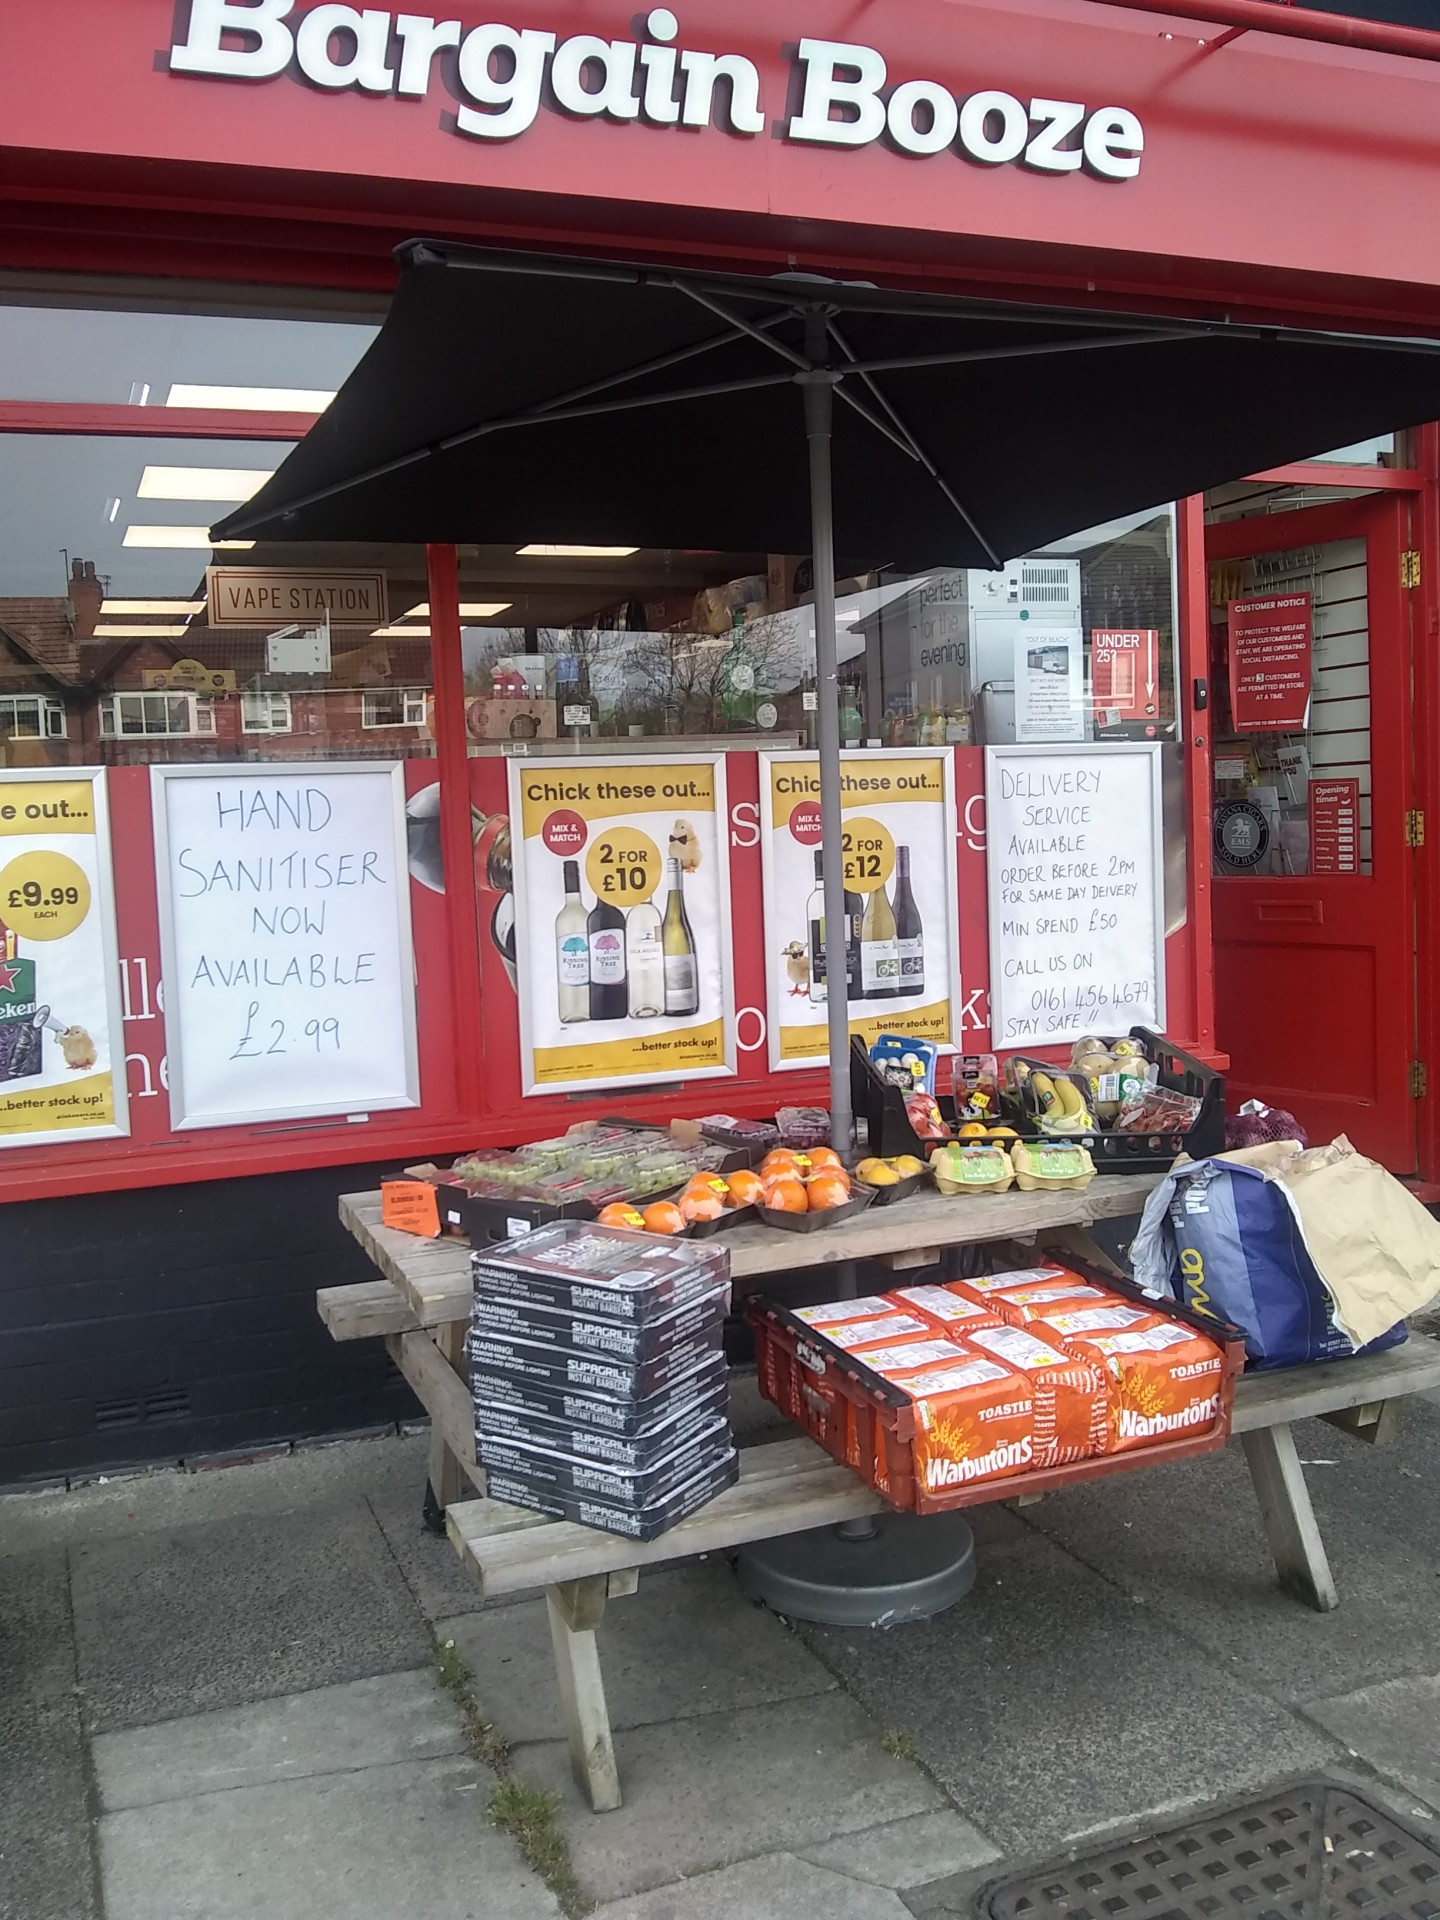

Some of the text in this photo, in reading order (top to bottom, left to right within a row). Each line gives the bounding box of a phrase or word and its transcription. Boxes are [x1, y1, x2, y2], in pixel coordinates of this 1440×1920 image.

[170, 0, 1145, 178] Bargain Booze
[228, 587, 370, 610] VAPE STATION
[920, 575, 963, 613] perfect
[1235, 598, 1306, 612] CUSTOMER NOTICE
[1245, 627, 1268, 636] PROTECT
[1282, 623, 1306, 632] WELFARE
[1258, 634, 1291, 644] CUSTOMERS
[1096, 634, 1140, 648] UNDER
[1262, 645, 1273, 653] ARE
[1273, 642, 1306, 652] OPERATING
[921, 638, 966, 667] evening
[1096, 648, 1117, 663] 25?
[1242, 656, 1261, 664] SOCIAL
[1237, 685, 1247, 693] ARE
[1248, 683, 1278, 692] PERMITTED
[1286, 681, 1305, 689] STORE
[1265, 672, 1301, 681] CUSTOMERS
[1281, 755, 1302, 767] THANK
[1282, 766, 1297, 776] YOU
[527, 781, 711, 802] Chick these out...
[776, 773, 940, 795] Chic these out...
[1001, 768, 1101, 800] DELIVERY
[1315, 785, 1350, 796] Opening
[25, 800, 89, 819] out...
[217, 788, 331, 832] HAND
[798, 815, 812, 823] MIX
[1022, 805, 1091, 826] SERVICE
[1217, 804, 1267, 831] HAVANA CIGARS
[550, 832, 581, 843] MATCH
[552, 823, 577, 833] MIX &
[796, 823, 823, 832] MATCH
[841, 833, 883, 852] 2 FOR
[1008, 834, 1086, 856] AVAILABLE
[1231, 837, 1251, 846] EMS
[599, 844, 648, 864] 2 FOR
[1220, 846, 1263, 863] SOLD HERE
[178, 848, 387, 898] SANITISER
[844, 855, 881, 878] £12
[1001, 855, 1135, 884] ORDER BEFORE 2PM
[602, 867, 647, 892] £10
[7, 880, 79, 908] £9.99
[1002, 888, 1026, 903] FOR
[1029, 887, 1063, 902] SAME
[1067, 886, 1087, 899] DAY
[34, 910, 58, 919] EACH
[252, 900, 326, 935] NOW
[1003, 908, 1117, 936] MIN SPEND £50
[191, 953, 376, 988] AVAILABLE
[1004, 952, 1093, 978] CALL US ON
[1031, 980, 1149, 1011] 0161 456 4679
[229, 1001, 341, 1061] £2.99
[868, 1016, 944, 1031] ...better stock up!
[1005, 1016, 1039, 1038] STAY
[632, 1036, 718, 1052] ...better stock up!
[48, 1094, 80, 1107] stock
[83, 1092, 104, 1106] up!
[478, 1267, 518, 1281] WARNING!
[570, 1285, 634, 1306] SUPAGRILL
[478, 1303, 519, 1318] WARNING!
[571, 1298, 635, 1317] INSTANT BARBECUE
[571, 1321, 635, 1342] SUPAGRILL
[472, 1340, 514, 1355] WARNING!
[572, 1334, 635, 1354] INSTANT BARBECUE
[567, 1359, 631, 1381] SUPAGRILL
[1169, 1357, 1221, 1379] TOASTIE
[563, 1395, 626, 1420] SUPAGRILL
[977, 1400, 1032, 1421] TOASTIE
[1120, 1392, 1220, 1438] Warburtons
[572, 1430, 636, 1453] SUPAGRILL
[926, 1435, 1033, 1487] Warburtons
[579, 1501, 640, 1525] SUPAGRILL
